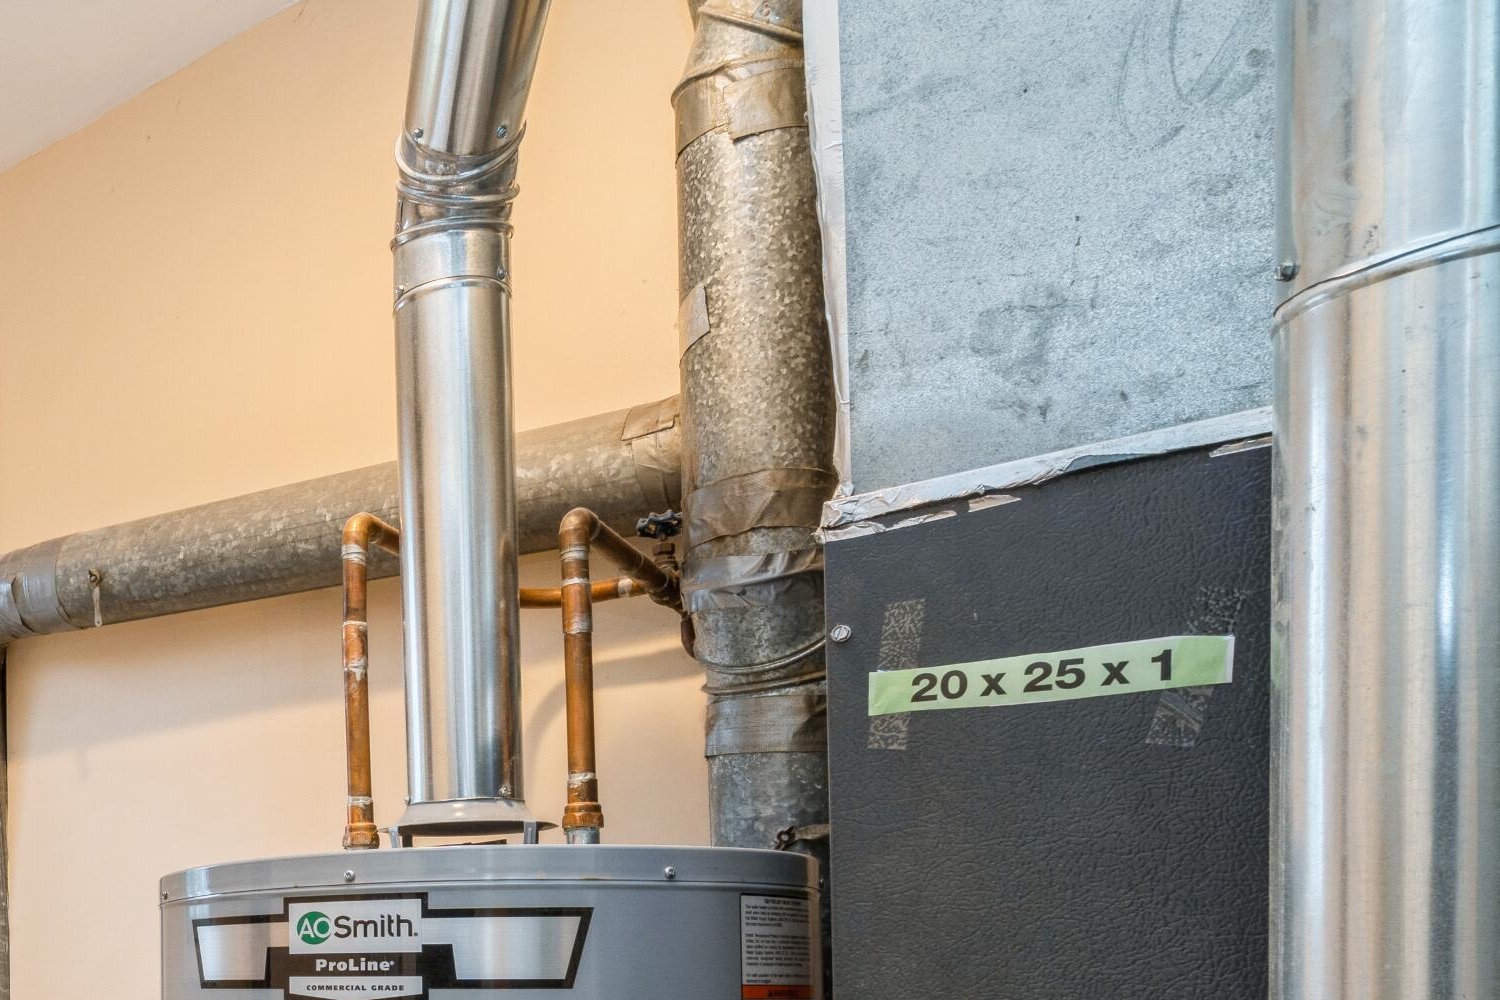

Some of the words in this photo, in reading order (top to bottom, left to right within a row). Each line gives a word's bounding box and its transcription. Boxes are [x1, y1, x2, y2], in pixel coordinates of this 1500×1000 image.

[911, 670, 968, 702] 20
[980, 672, 1007, 697] x
[1023, 658, 1086, 692] 25
[1100, 661, 1131, 686] x
[1151, 649, 1173, 681] 1
[334, 914, 413, 938] Smith
[315, 957, 391, 972] ProLine
